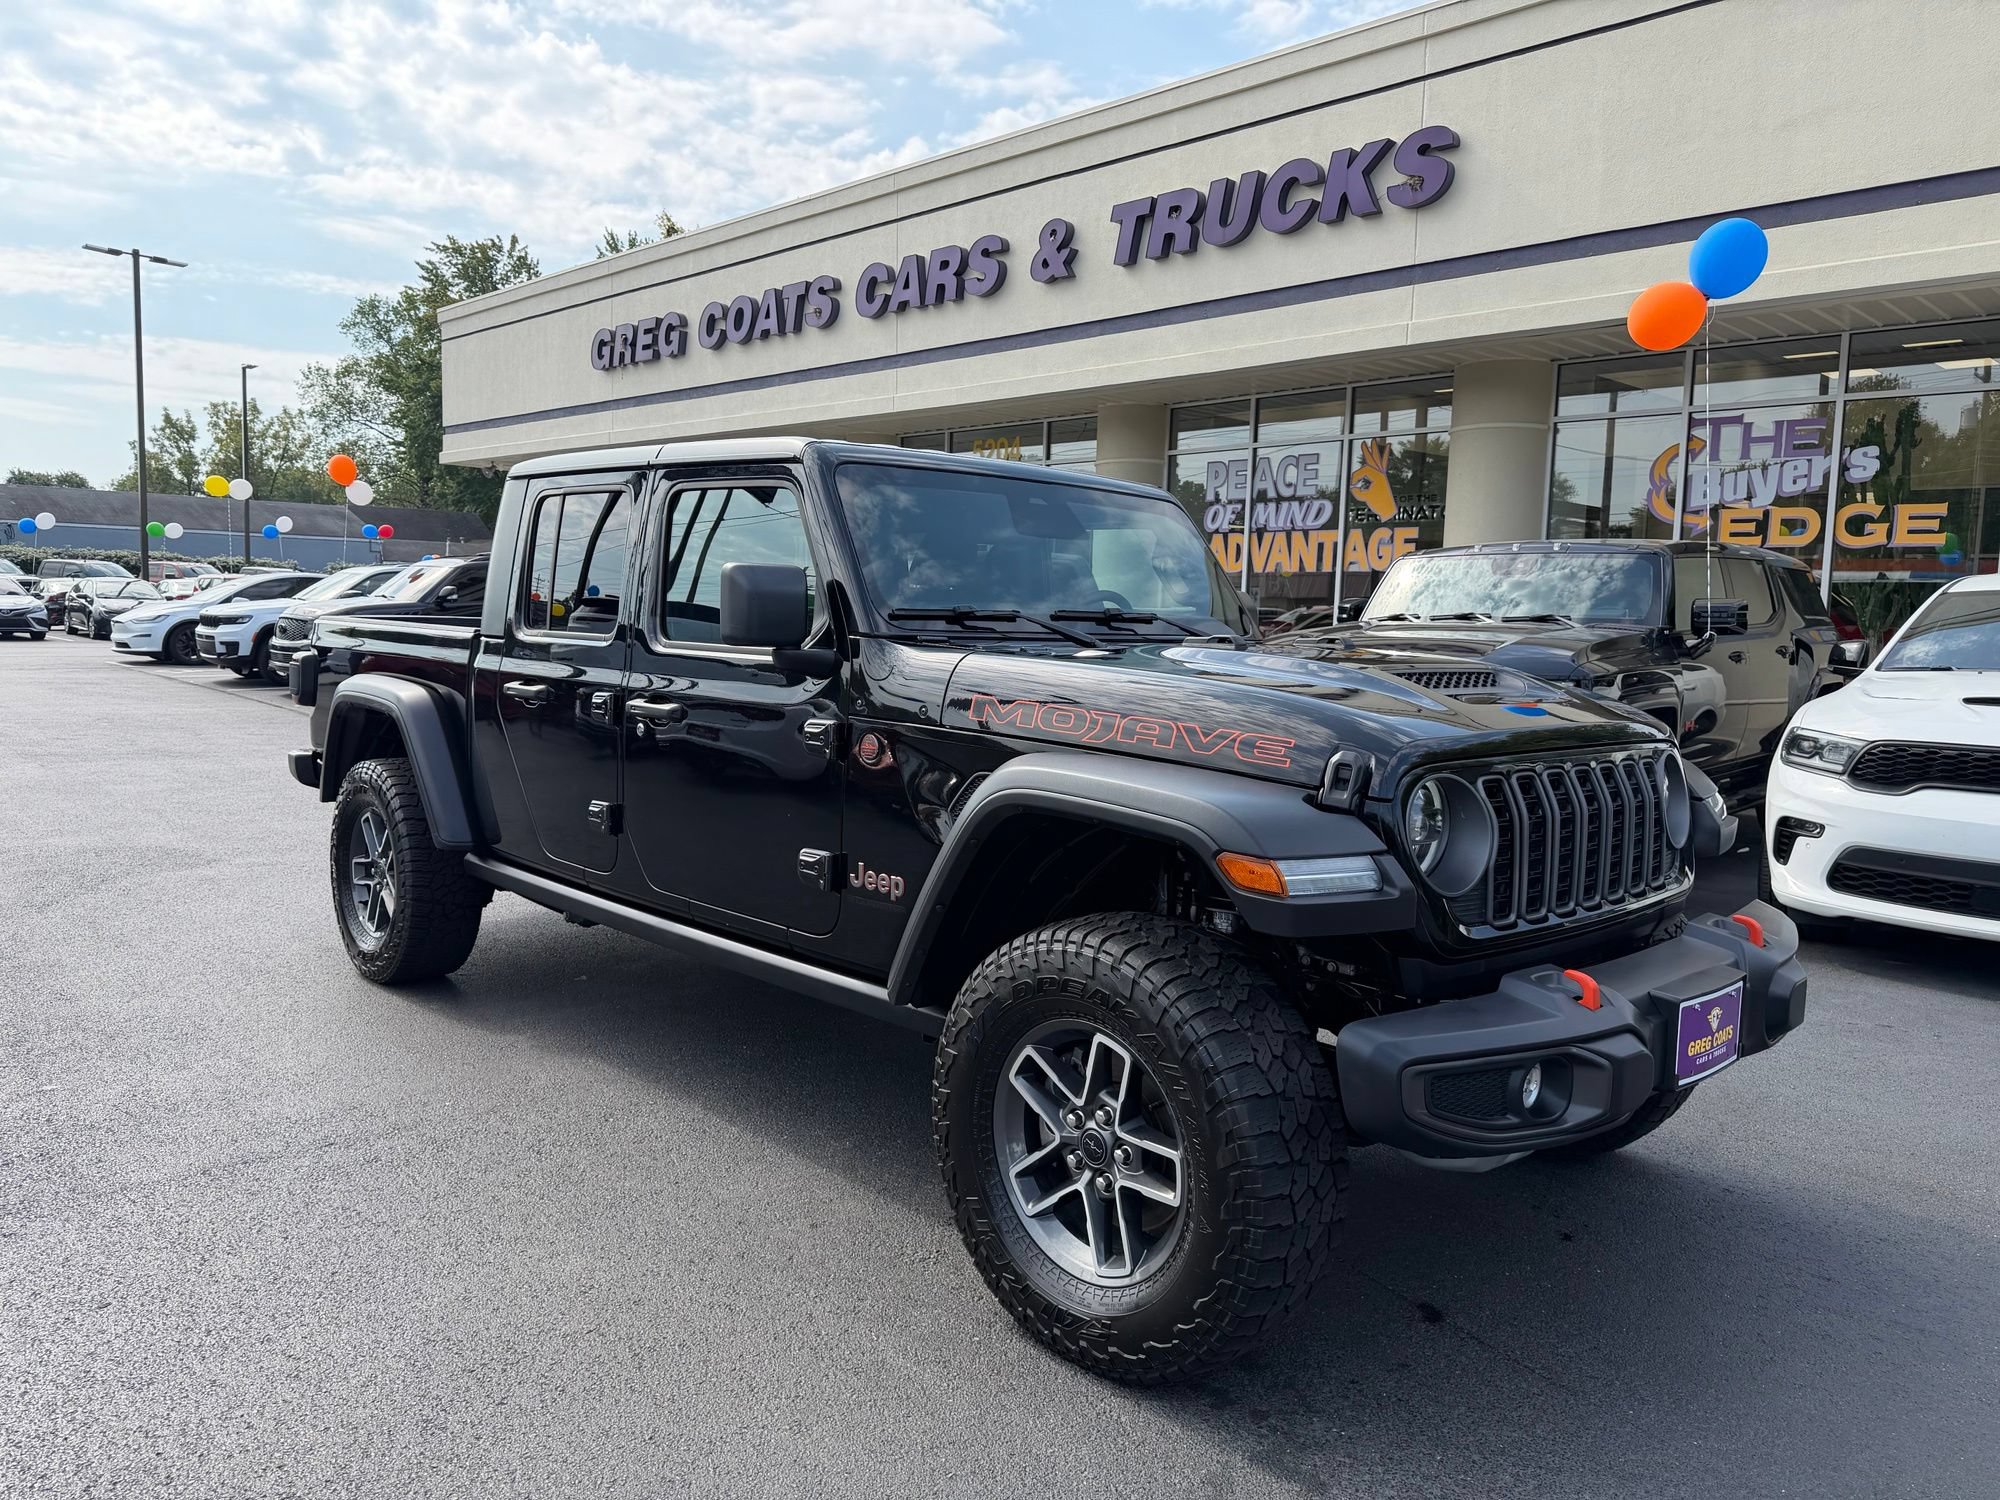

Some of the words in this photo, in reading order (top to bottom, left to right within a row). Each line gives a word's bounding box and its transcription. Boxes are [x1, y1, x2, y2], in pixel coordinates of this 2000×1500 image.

[591, 311, 688, 371] GREG
[698, 275, 842, 350] COATS
[856, 235, 1010, 319] CARS
[1030, 218, 1079, 284] &
[1110, 125, 1461, 267] TRUCKS
[1690, 413, 1827, 461] THE
[1205, 453, 1320, 501] PEACE
[1686, 445, 1881, 511] Buyer's
[1203, 502, 1243, 533] OF
[1251, 500, 1333, 533] MIND
[1718, 502, 1949, 548] EDGE
[968, 694, 1296, 768] MOJAVE
[850, 861, 906, 901] Jeep
[1687, 1035, 1712, 1057] GREG
[1713, 1025, 1734, 1048] COATS
